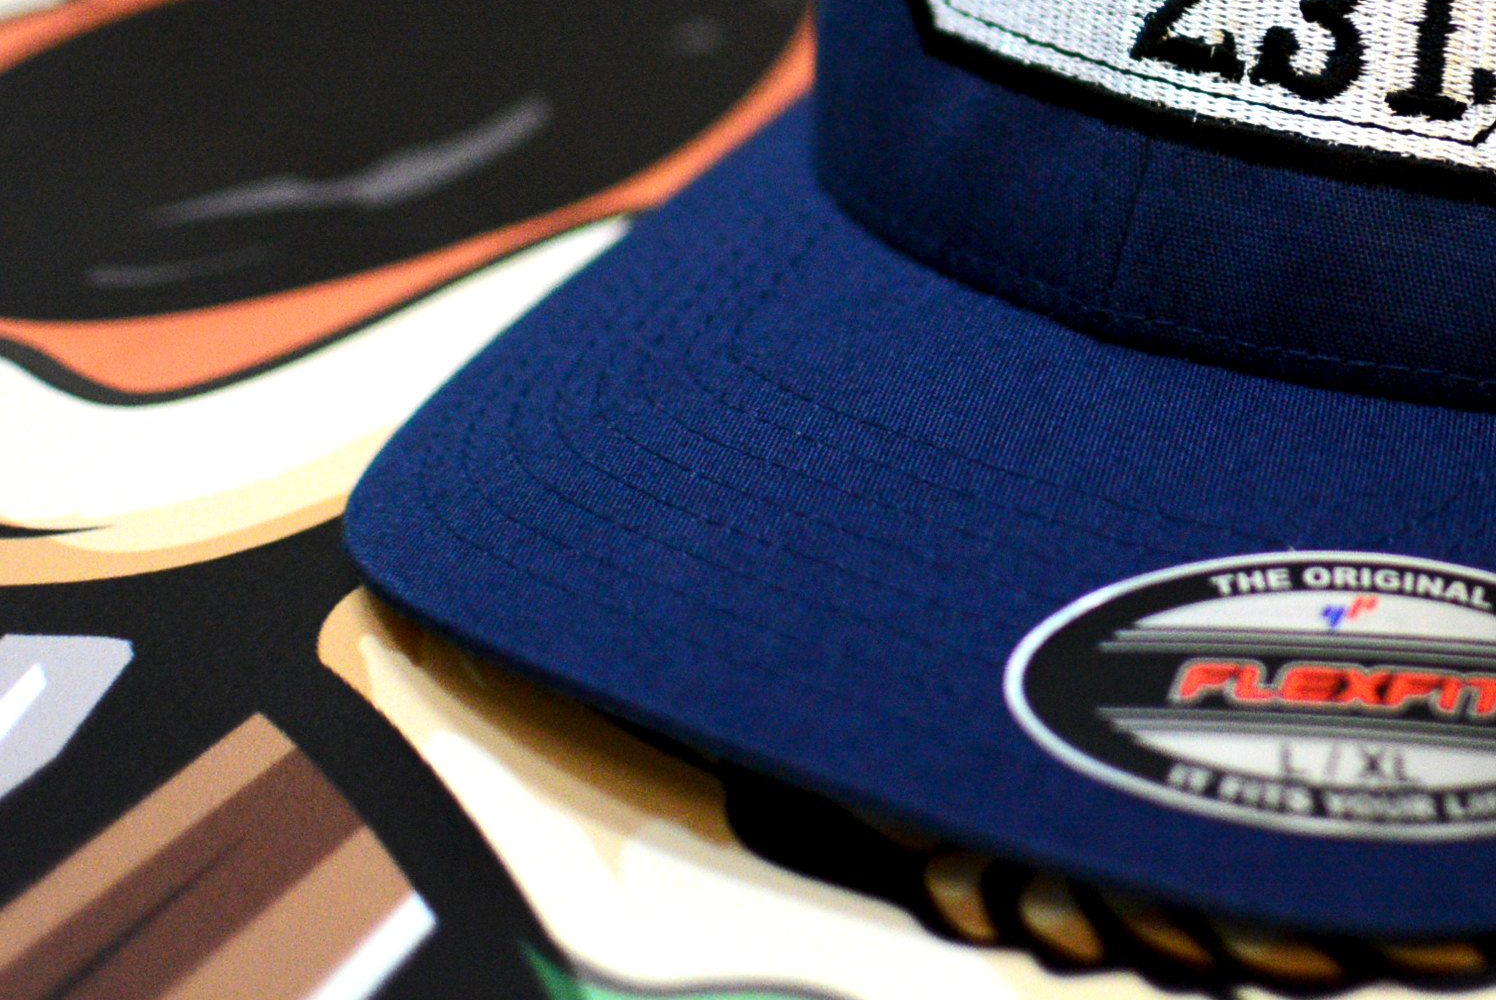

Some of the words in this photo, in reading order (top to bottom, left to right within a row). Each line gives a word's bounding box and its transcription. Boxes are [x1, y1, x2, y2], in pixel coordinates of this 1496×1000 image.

[1209, 567, 1293, 597] THE
[1302, 565, 1494, 610] ORIGINAL
[1323, 789, 1437, 822] YOUR
